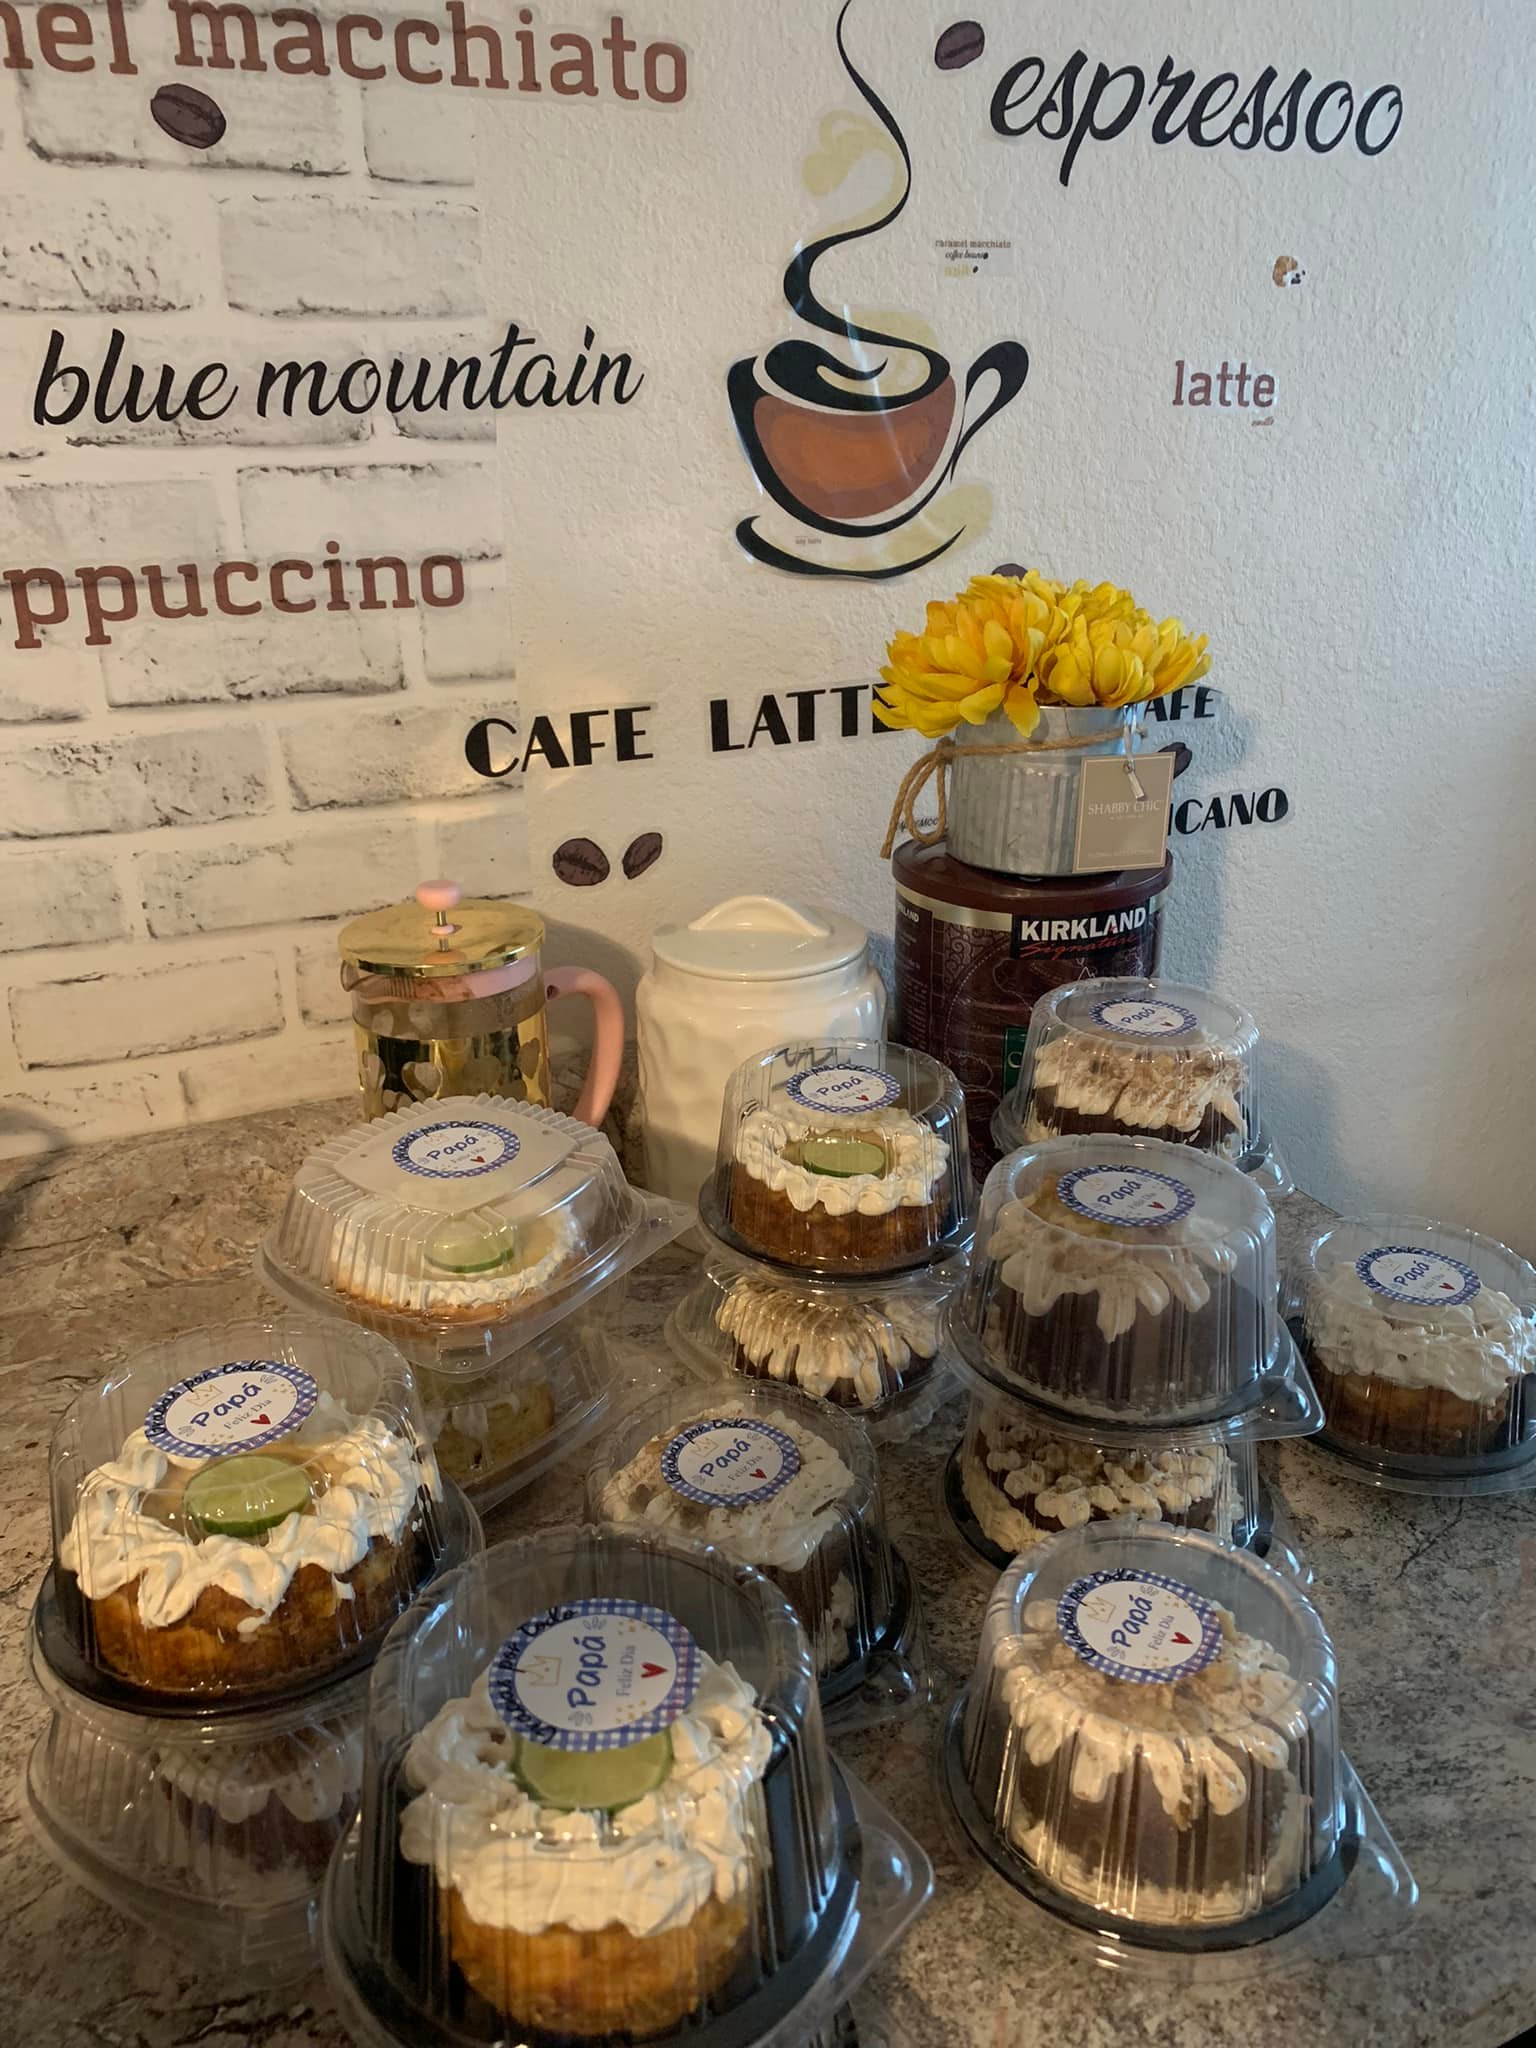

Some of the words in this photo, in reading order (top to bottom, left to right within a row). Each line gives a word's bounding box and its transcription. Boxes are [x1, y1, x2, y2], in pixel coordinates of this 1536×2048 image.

[173, 0, 688, 103] macchiato
[990, 49, 1403, 187] espressoo
[33, 328, 239, 426] blue
[256, 323, 645, 420] mountain
[1172, 360, 1275, 408] latte
[3, 541, 465, 650] ppuccino
[465, 706, 654, 779] CAFE
[1144, 685, 1223, 723] AFE
[1088, 801, 1130, 816] SHABBY
[1133, 799, 1161, 813] CHIC
[1167, 787, 1289, 836] CANO
[1020, 934, 1138, 961] Signature
[1021, 907, 1147, 942] KIRKLAND
[426, 1134, 479, 1160] Papá
[1097, 1179, 1143, 1206] Papá
[190, 1382, 263, 1427] Papá
[699, 1438, 751, 1477] Papá
[1111, 1594, 1153, 1648] Papá
[566, 1635, 609, 1709] Papá
[616, 1667, 633, 1697] Feliz
